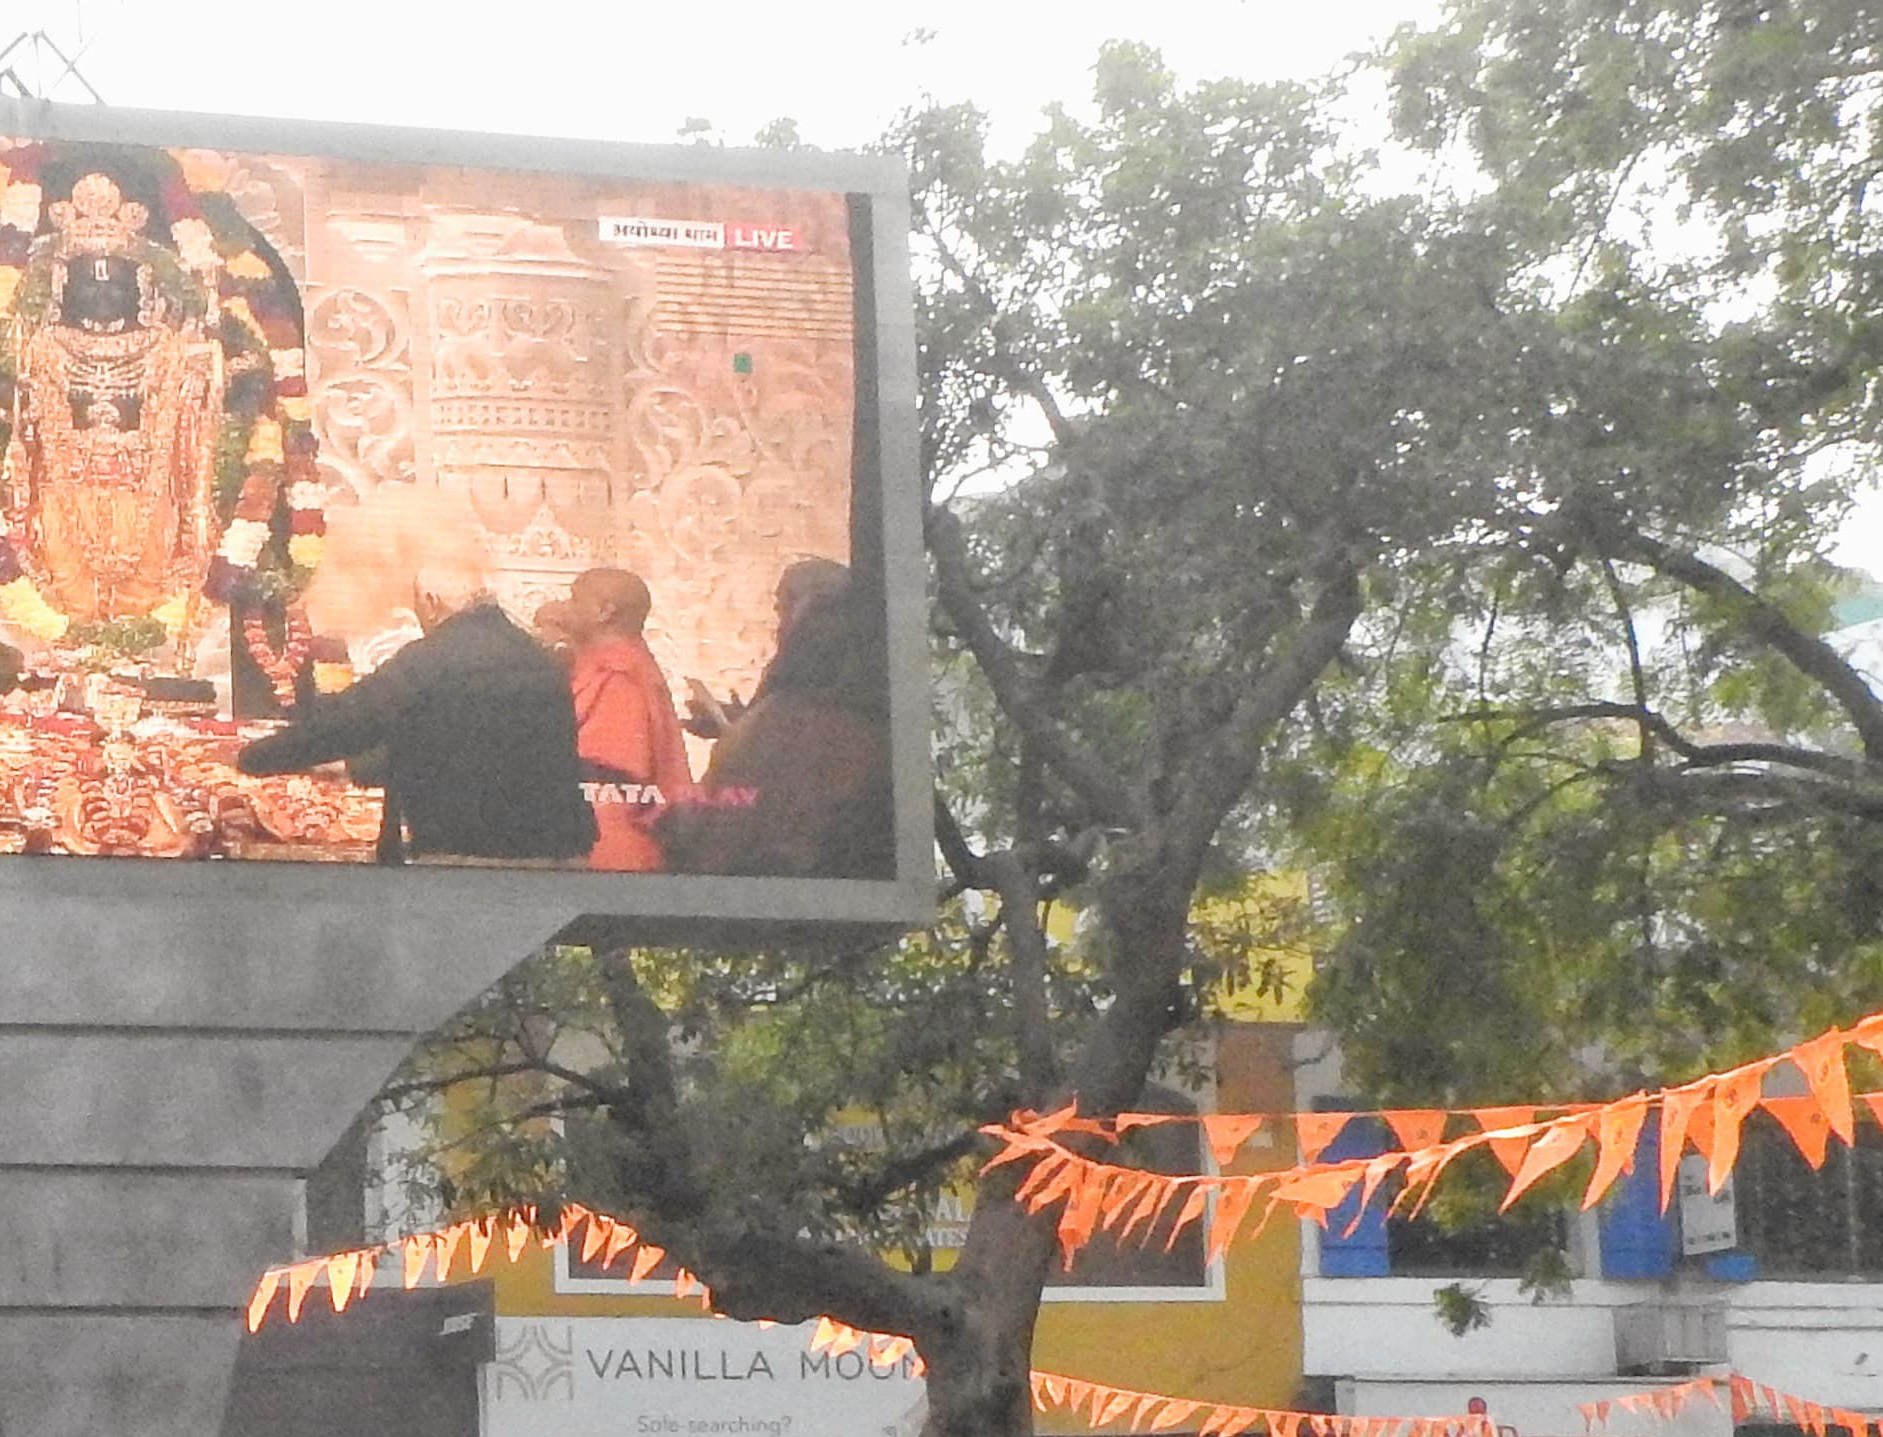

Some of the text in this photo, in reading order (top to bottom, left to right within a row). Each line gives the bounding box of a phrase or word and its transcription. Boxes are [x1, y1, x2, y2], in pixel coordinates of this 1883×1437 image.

[734, 229, 793, 248] LIVE
[578, 782, 666, 804] TATA
[586, 1350, 774, 1380] VANILLA
[637, 1415, 792, 1435] Sole-searching?
